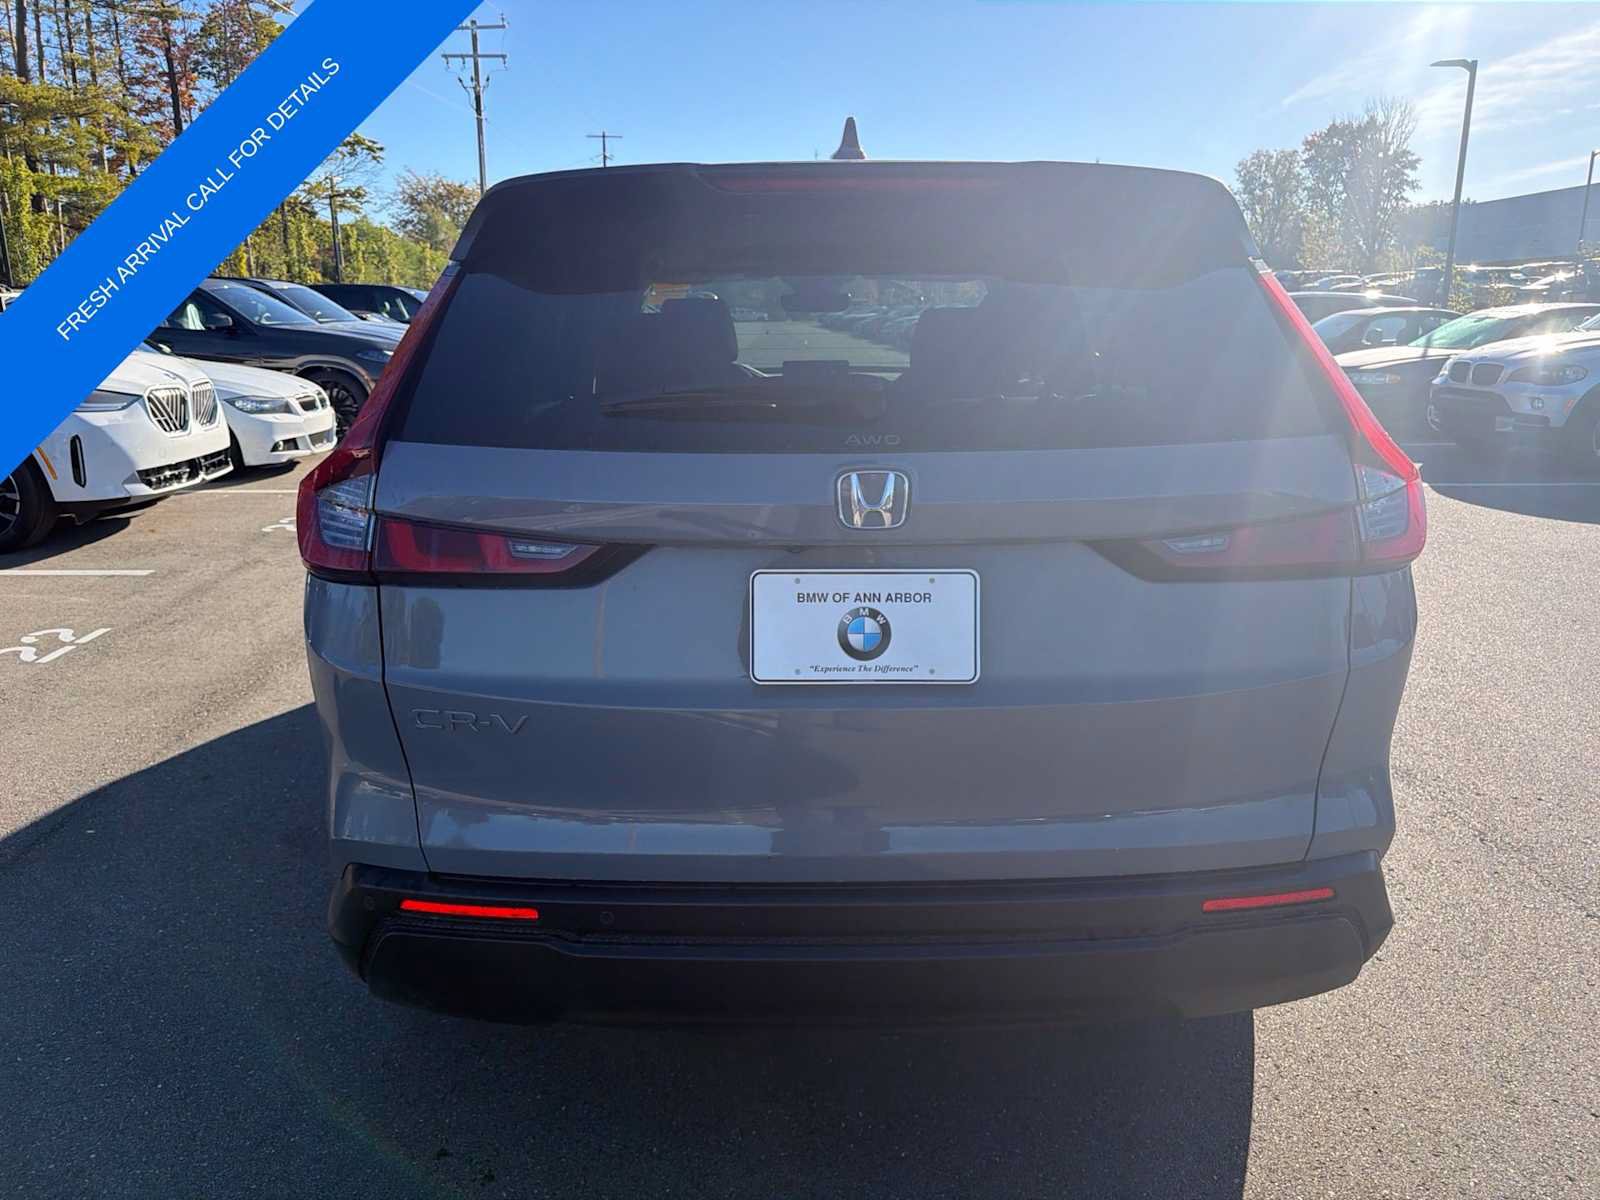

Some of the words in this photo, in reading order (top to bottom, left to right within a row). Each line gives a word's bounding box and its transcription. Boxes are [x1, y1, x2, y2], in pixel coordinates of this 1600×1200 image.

[845, 433, 902, 447] AWD
[797, 592, 828, 603] BMW
[832, 592, 850, 603] OF
[853, 592, 881, 603] ANN
[885, 592, 932, 603] ARBOR
[842, 607, 887, 625] BMW
[858, 664, 872, 673] The
[411, 708, 529, 735] CR-V
